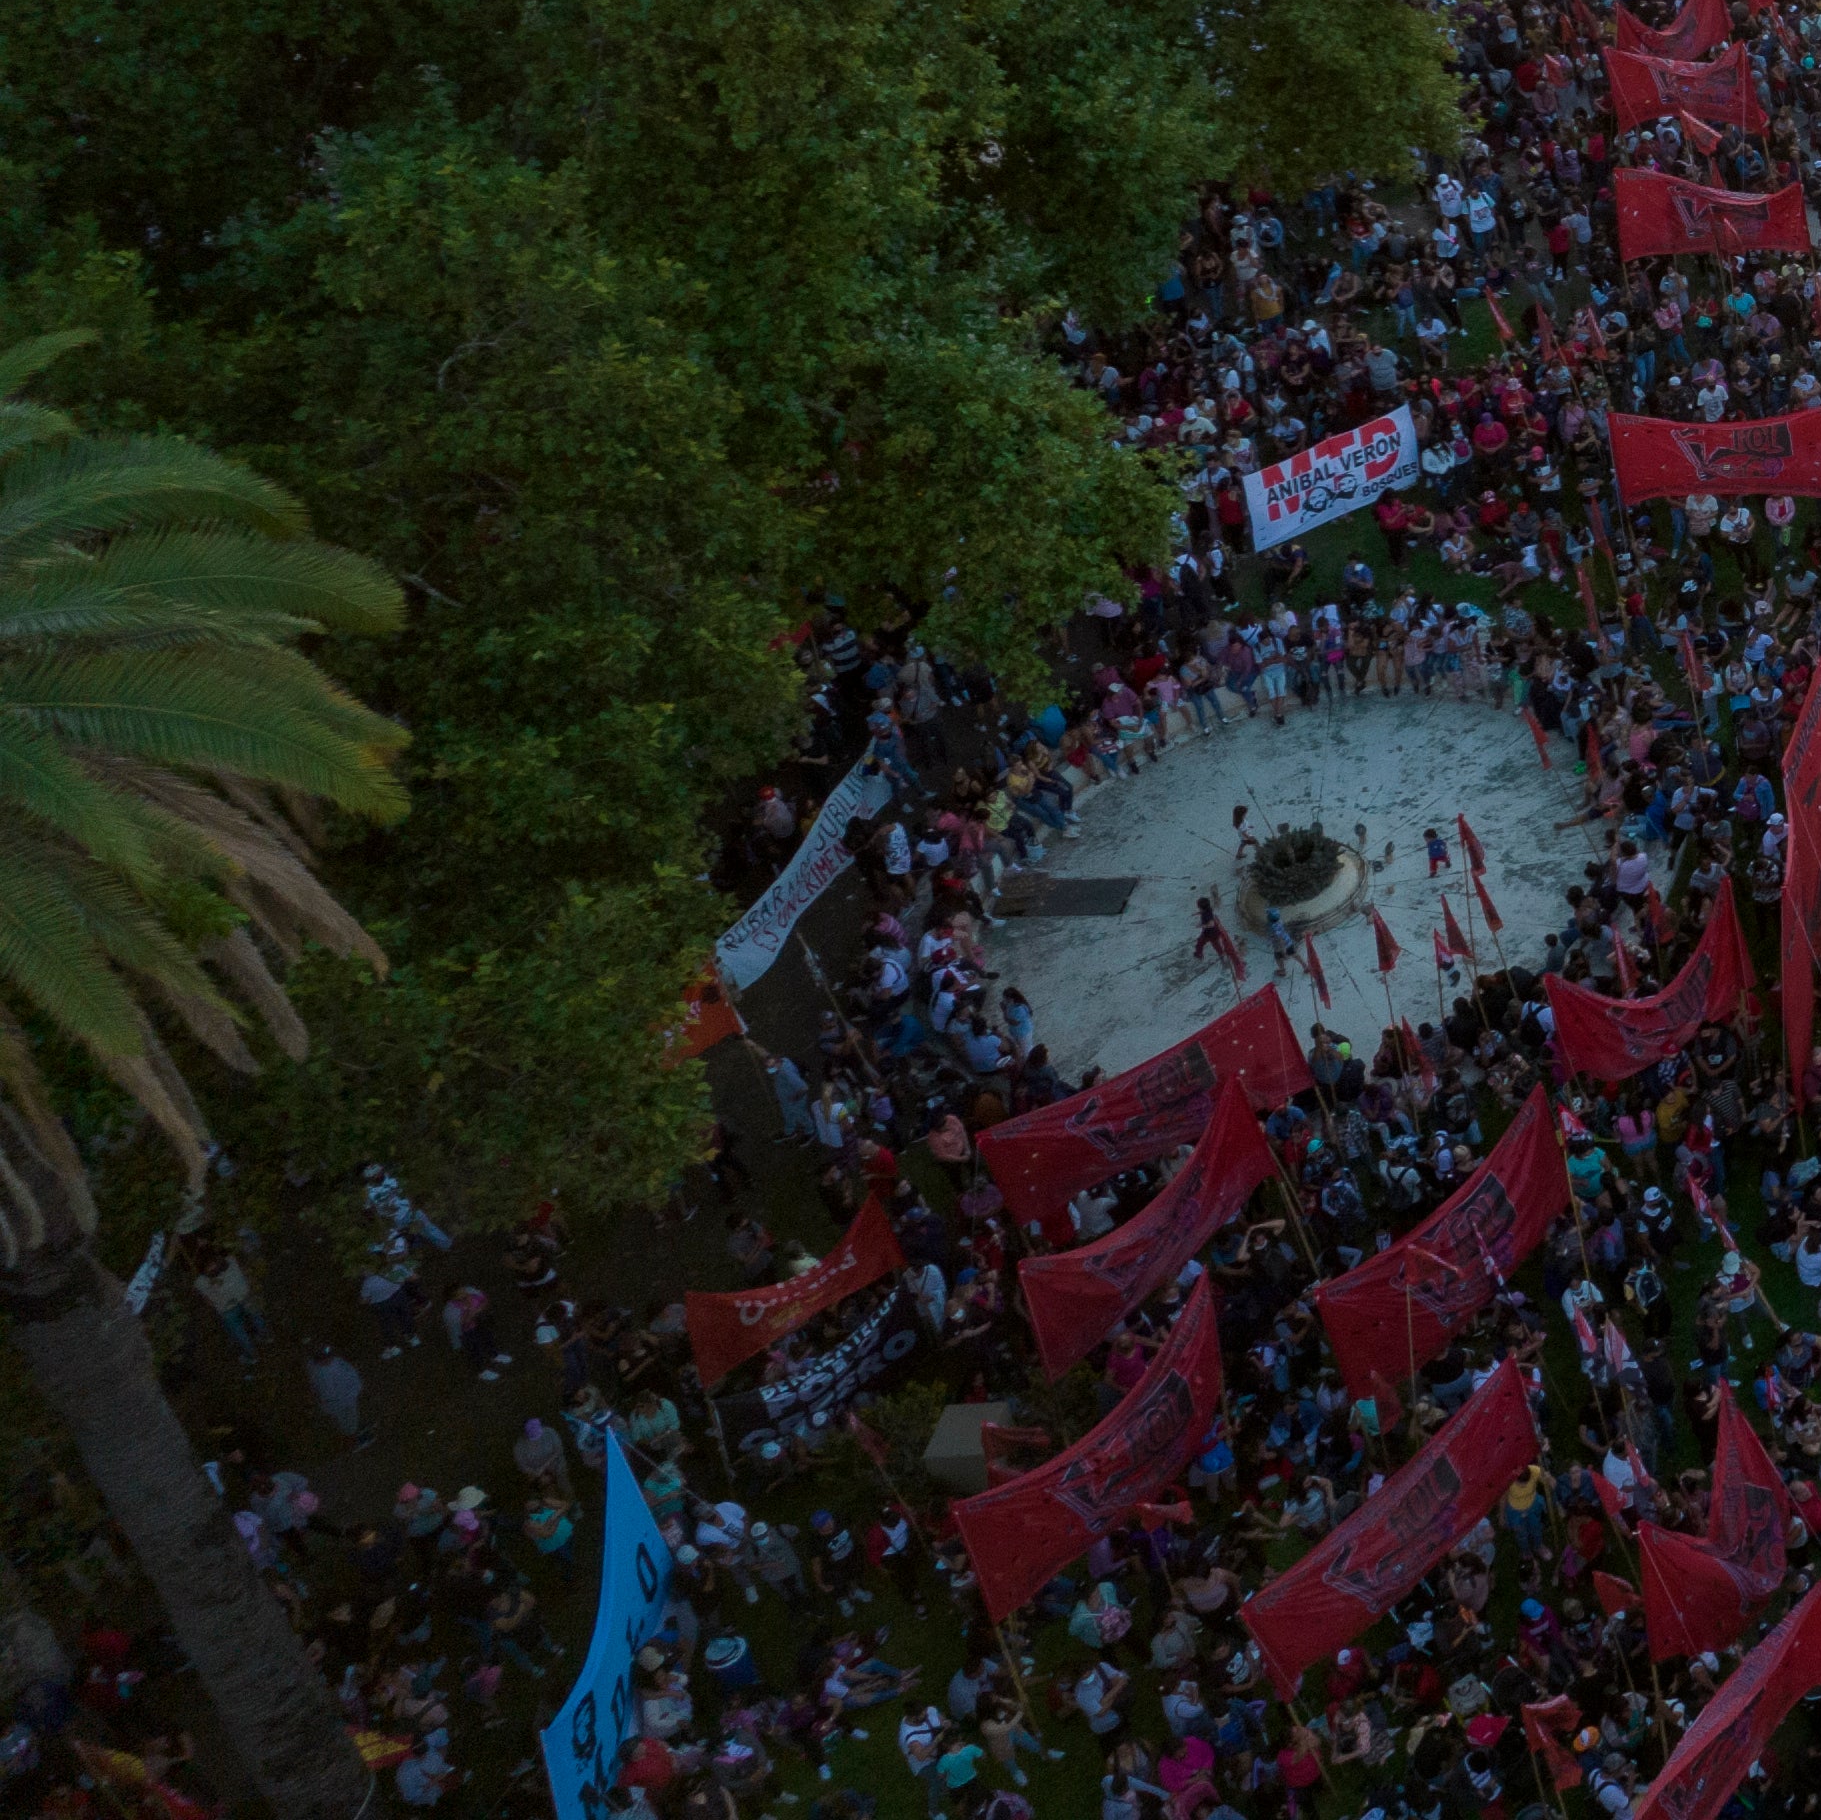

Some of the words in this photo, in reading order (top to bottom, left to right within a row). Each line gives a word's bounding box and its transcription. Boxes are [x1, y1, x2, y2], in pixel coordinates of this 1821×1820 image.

[1266, 458, 1336, 506] ANIBAL
[1340, 432, 1401, 472] VERON
[1361, 460, 1419, 495] BOSQUES
